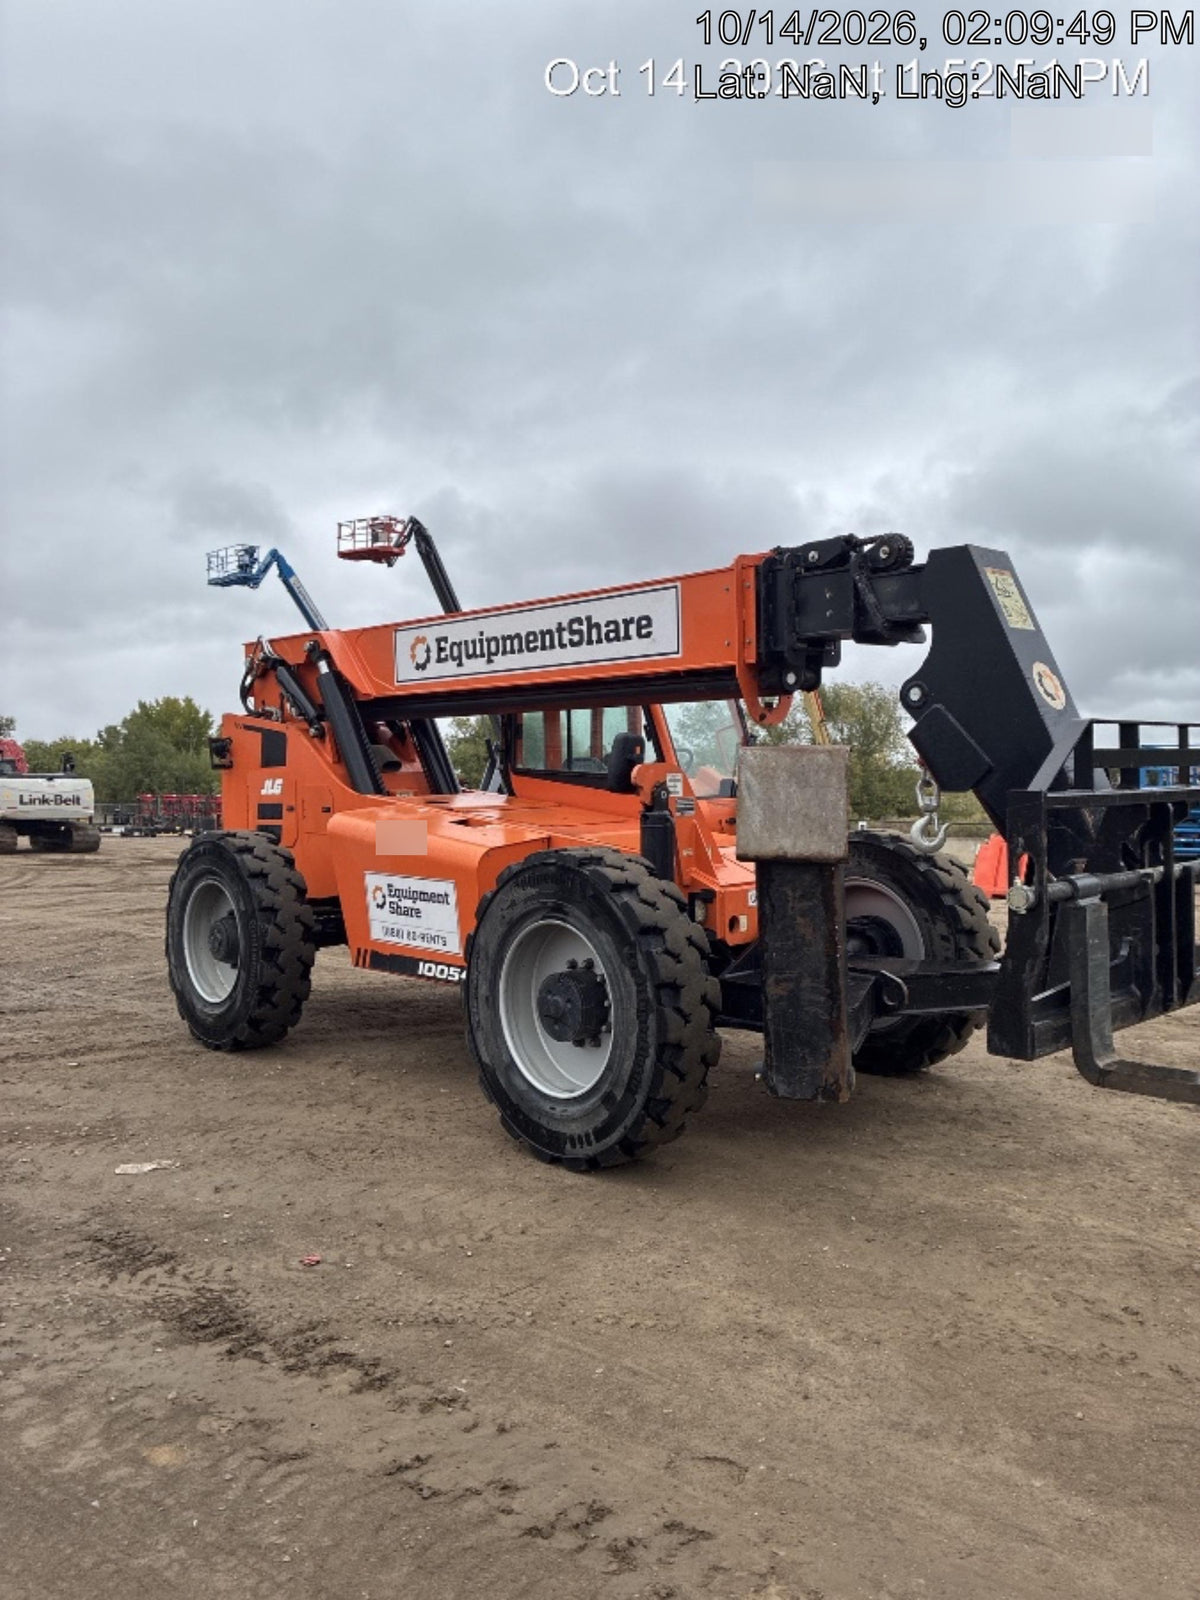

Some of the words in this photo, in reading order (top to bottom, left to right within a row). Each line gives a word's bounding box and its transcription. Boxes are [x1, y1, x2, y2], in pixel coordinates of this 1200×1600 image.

[434, 613, 653, 668] EquipmentShare
[260, 777, 284, 796] JLG
[18, 794, 81, 806] Link-Belt
[386, 882, 451, 906] Equipment
[388, 901, 422, 919] Share
